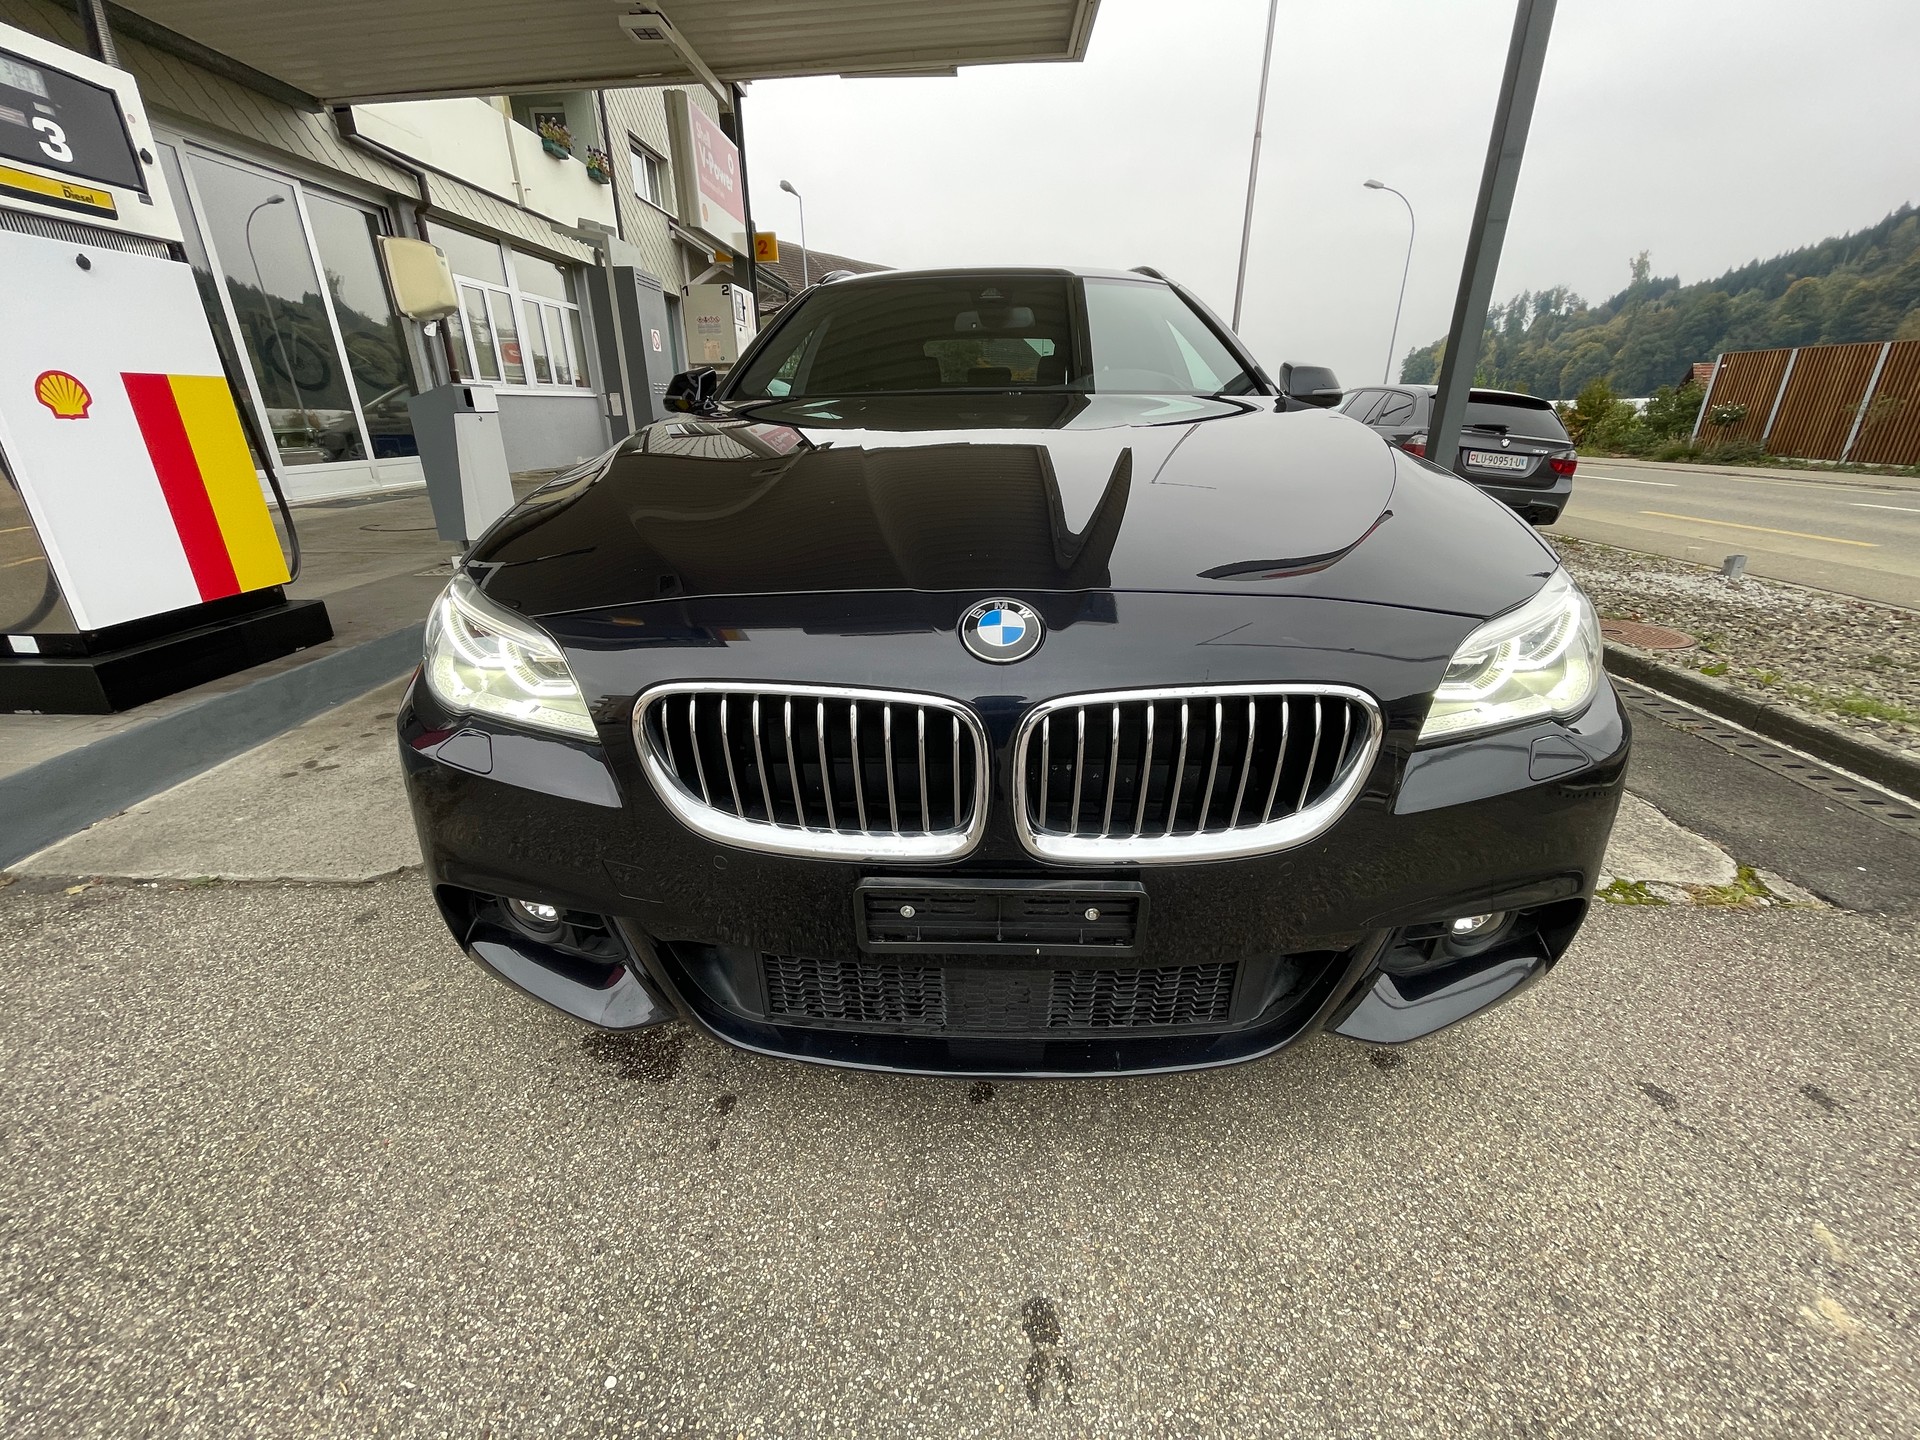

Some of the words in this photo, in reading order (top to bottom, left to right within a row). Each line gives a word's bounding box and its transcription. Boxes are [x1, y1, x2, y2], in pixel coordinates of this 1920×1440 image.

[31, 116, 74, 163] 3
[695, 120, 712, 150] Shell
[698, 141, 734, 193] V-Power
[63, 189, 95, 204] Diesel
[757, 239, 769, 255] 2
[682, 285, 690, 297] 1
[721, 284, 730, 296] 2
[971, 602, 1034, 619] BMW
